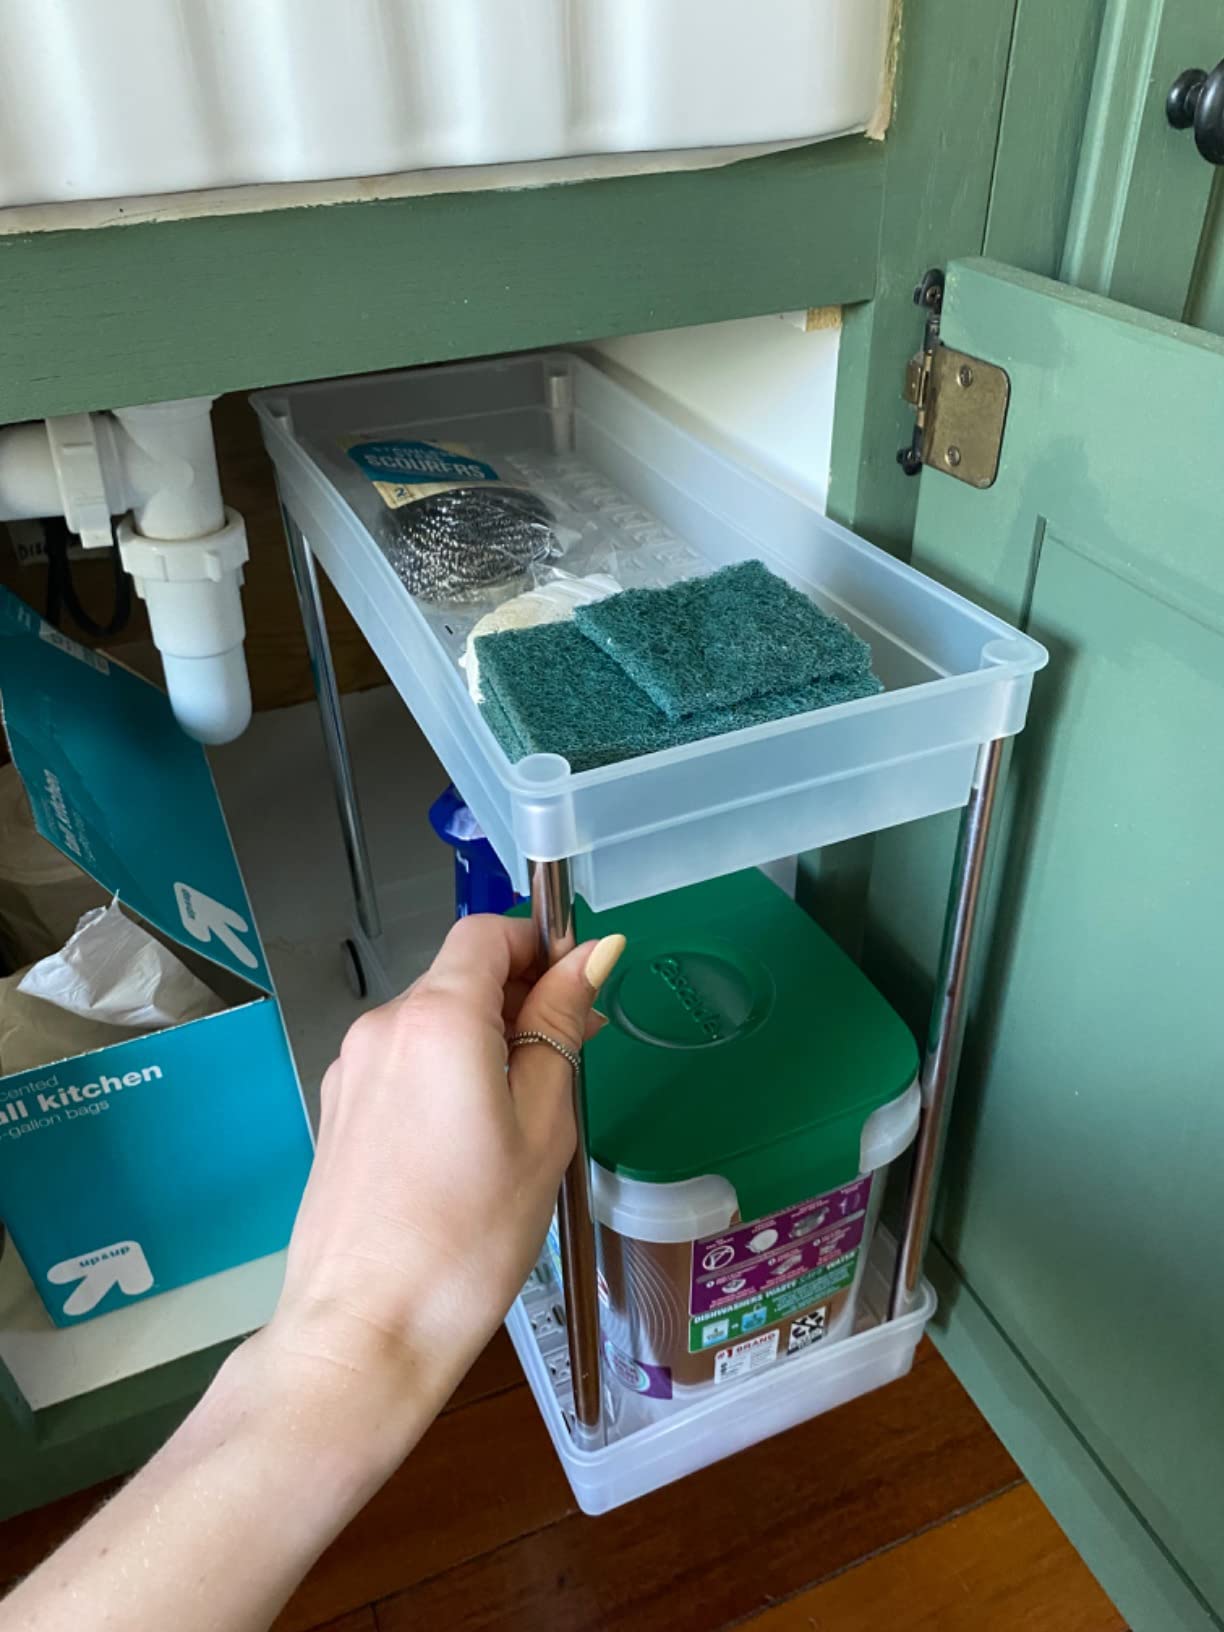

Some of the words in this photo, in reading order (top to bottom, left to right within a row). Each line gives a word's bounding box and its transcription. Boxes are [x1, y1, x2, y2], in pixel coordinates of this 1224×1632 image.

[36, 1064, 163, 1112] kitchen
[65, 1100, 110, 1119] bags
[736, 1333, 776, 1354] BRAND
